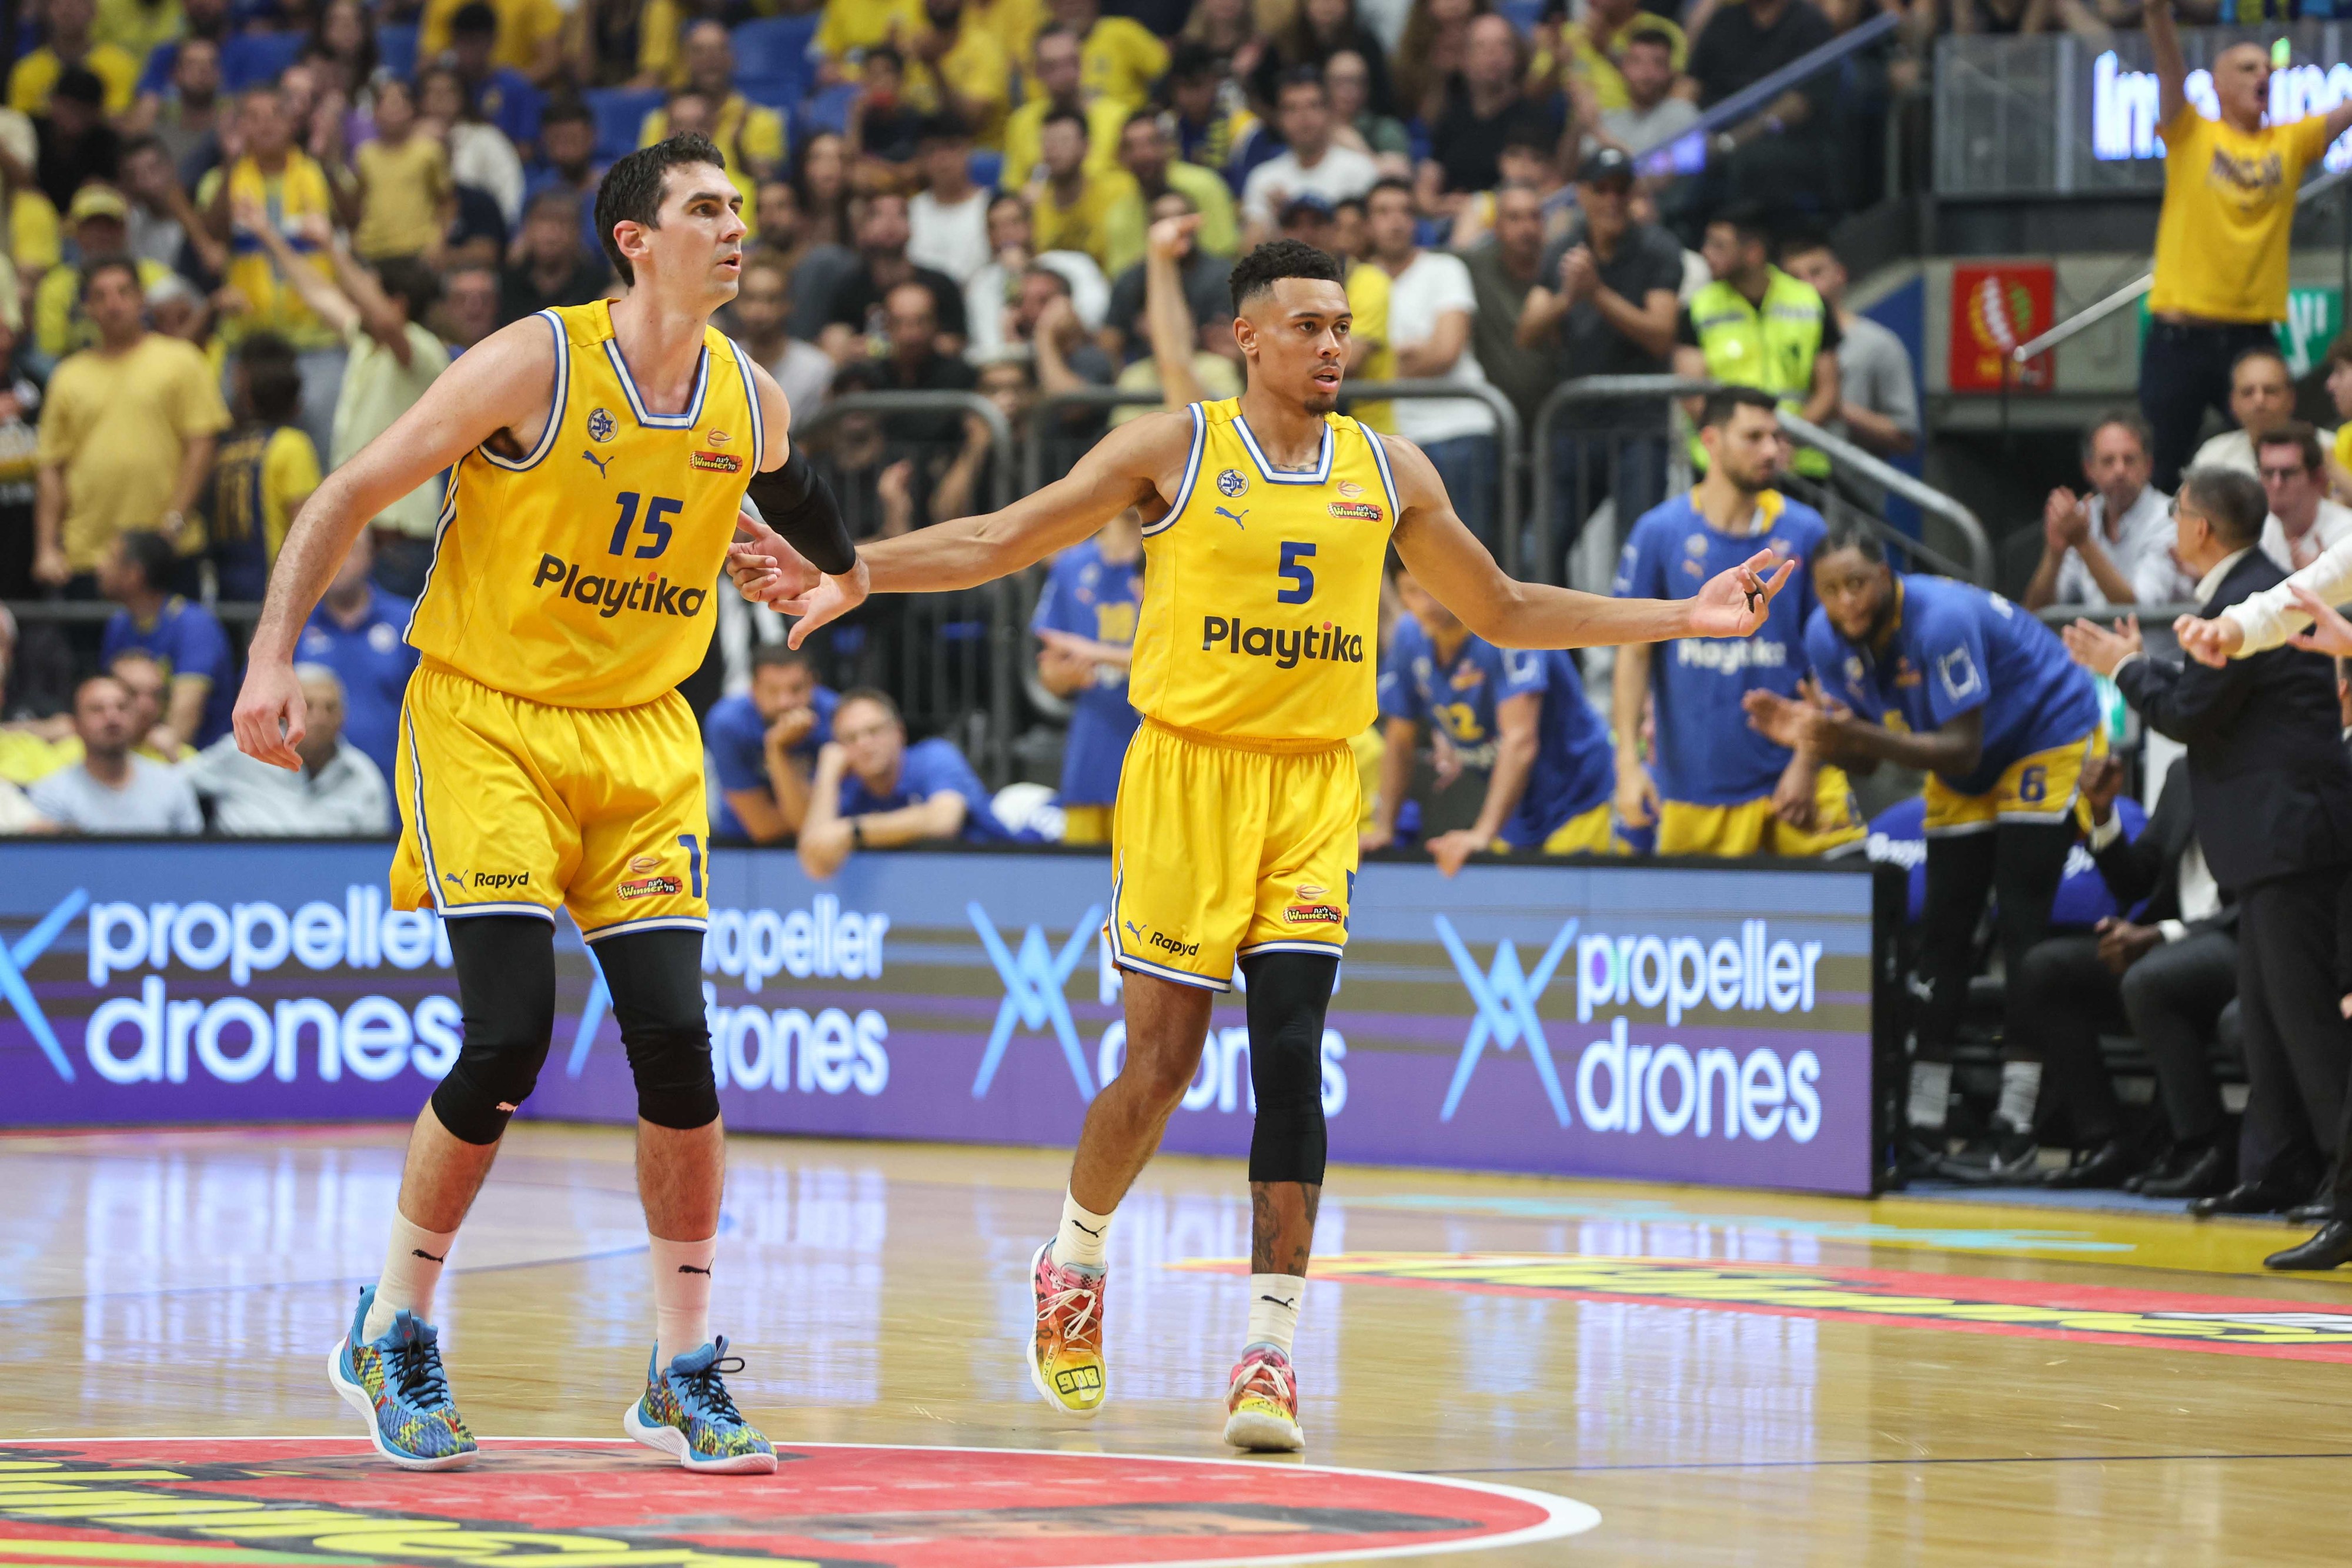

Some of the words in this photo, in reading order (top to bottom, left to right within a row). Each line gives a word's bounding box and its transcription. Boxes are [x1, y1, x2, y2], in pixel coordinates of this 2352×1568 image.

[694, 456, 728, 469] Winner
[609, 492, 683, 559] 15
[1332, 506, 1369, 517] Winner
[533, 553, 707, 618] Playtika
[1278, 541, 1316, 604] 5
[1202, 616, 1363, 669] Playtika
[2020, 764, 2047, 801] 6
[474, 871, 529, 889] Rapyd
[623, 885, 663, 897] Winner
[1288, 911, 1328, 921] Winner
[1150, 931, 1200, 957] Rapyd
[1576, 917, 1822, 1027] propeller
[85, 974, 465, 1085] drones
[702, 980, 890, 1096] rones
[1575, 1015, 1822, 1143] drones
